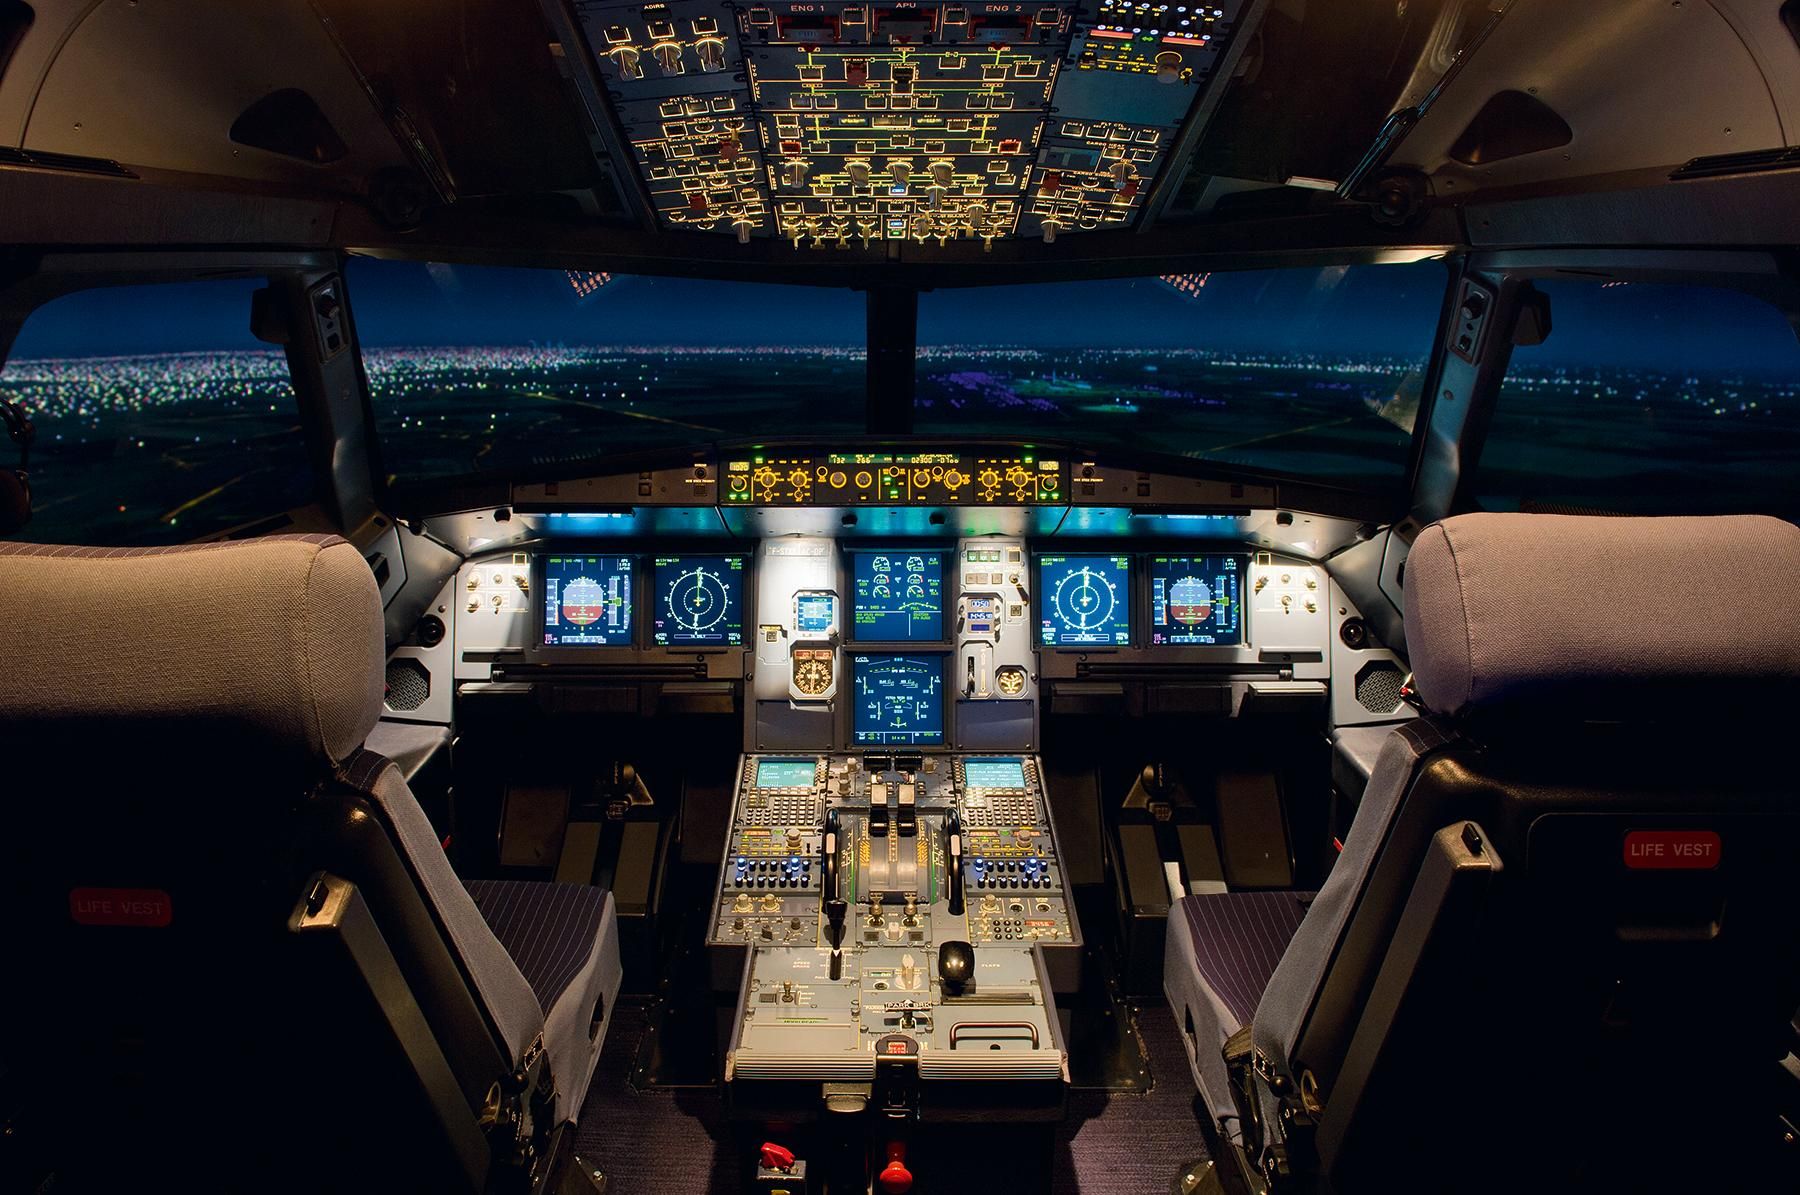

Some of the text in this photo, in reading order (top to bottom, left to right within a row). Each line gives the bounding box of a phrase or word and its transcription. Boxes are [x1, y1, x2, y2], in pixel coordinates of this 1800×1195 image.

[1631, 843, 1713, 856] LIFE VEST
[78, 900, 162, 915] LIFE VEST
